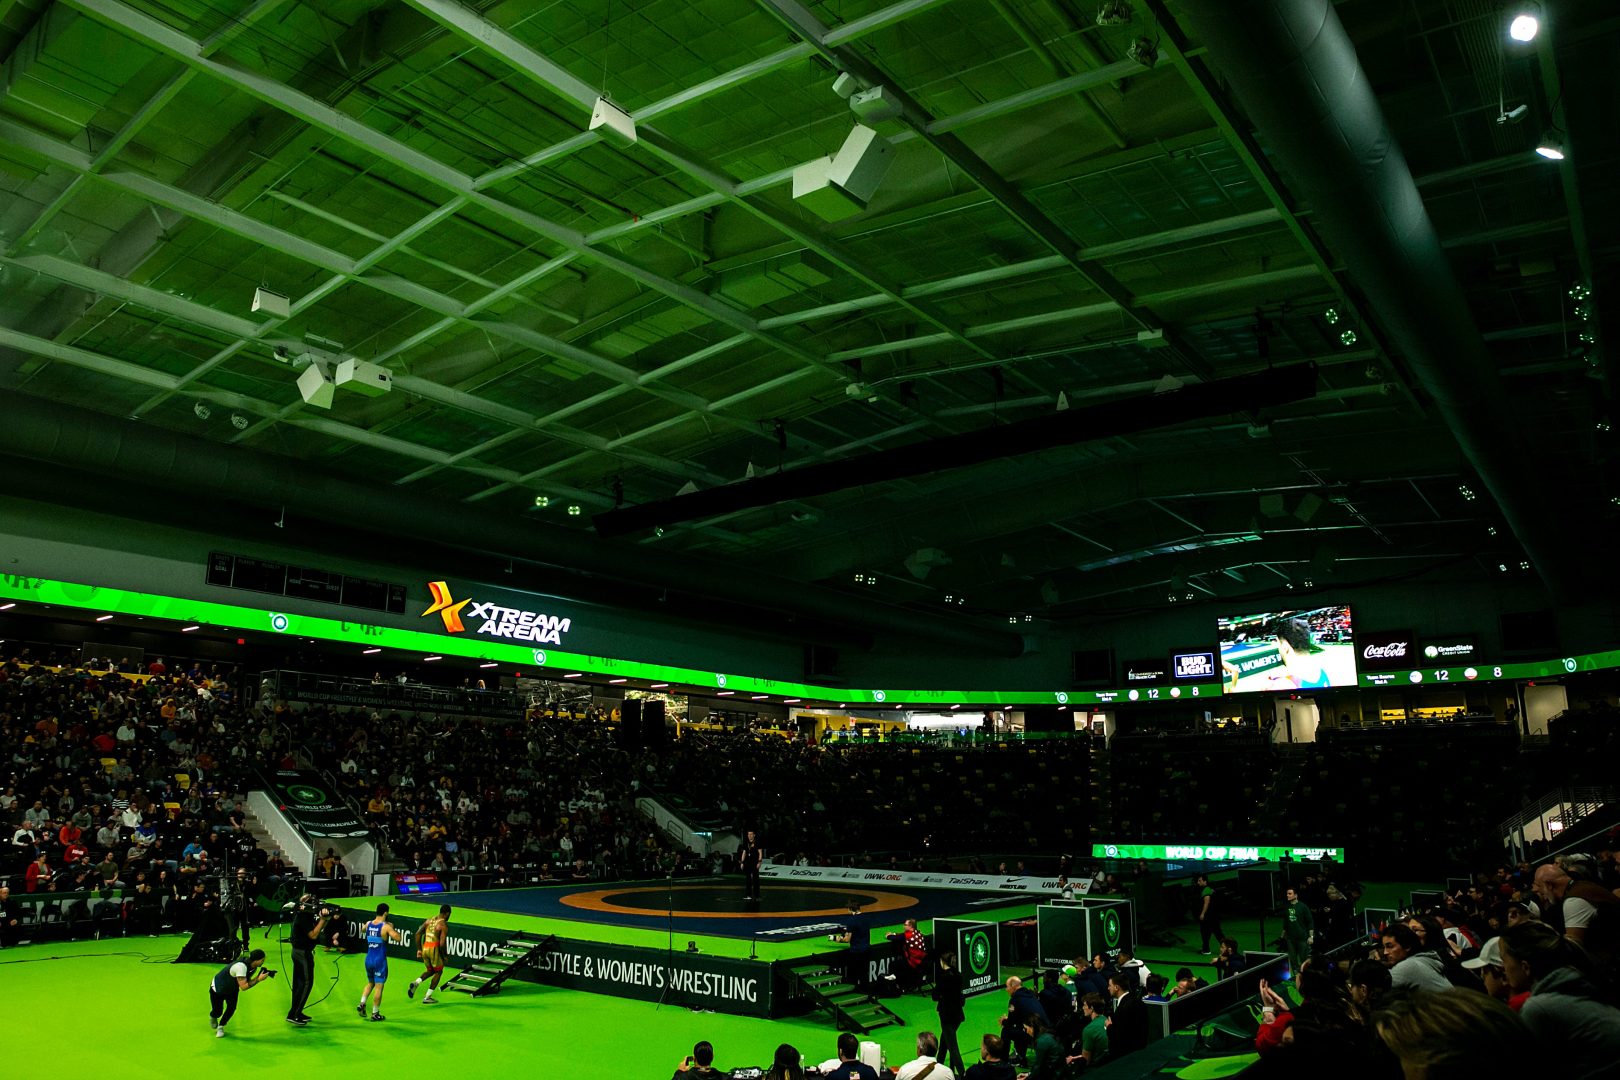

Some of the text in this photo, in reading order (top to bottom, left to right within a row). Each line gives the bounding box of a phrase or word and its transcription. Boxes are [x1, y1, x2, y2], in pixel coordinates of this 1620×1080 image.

[467, 601, 571, 633] XTREAM
[477, 620, 561, 645] ARENA
[1363, 642, 1407, 659] Coca-Cola
[1438, 645, 1474, 653] GreenState
[1181, 656, 1206, 666] BUD
[1241, 654, 1279, 672] WOMEN'S
[1177, 664, 1212, 676] LIGHT
[1434, 670, 1449, 681] 12
[1494, 666, 1503, 678] 8
[1147, 689, 1159, 699] 12
[1192, 686, 1199, 696] 8
[1165, 845, 1259, 860] WORLD CUP FINAL
[789, 869, 823, 877] TaiShan
[864, 873, 902, 881] UWW.ORG
[948, 877, 989, 885] TaiShan
[446, 936, 487, 960] WORLD
[583, 956, 594, 978] &
[596, 957, 664, 988] WOMEN'S
[667, 967, 757, 1003] WRESTLING
[969, 974, 992, 987] WORLD CUP
